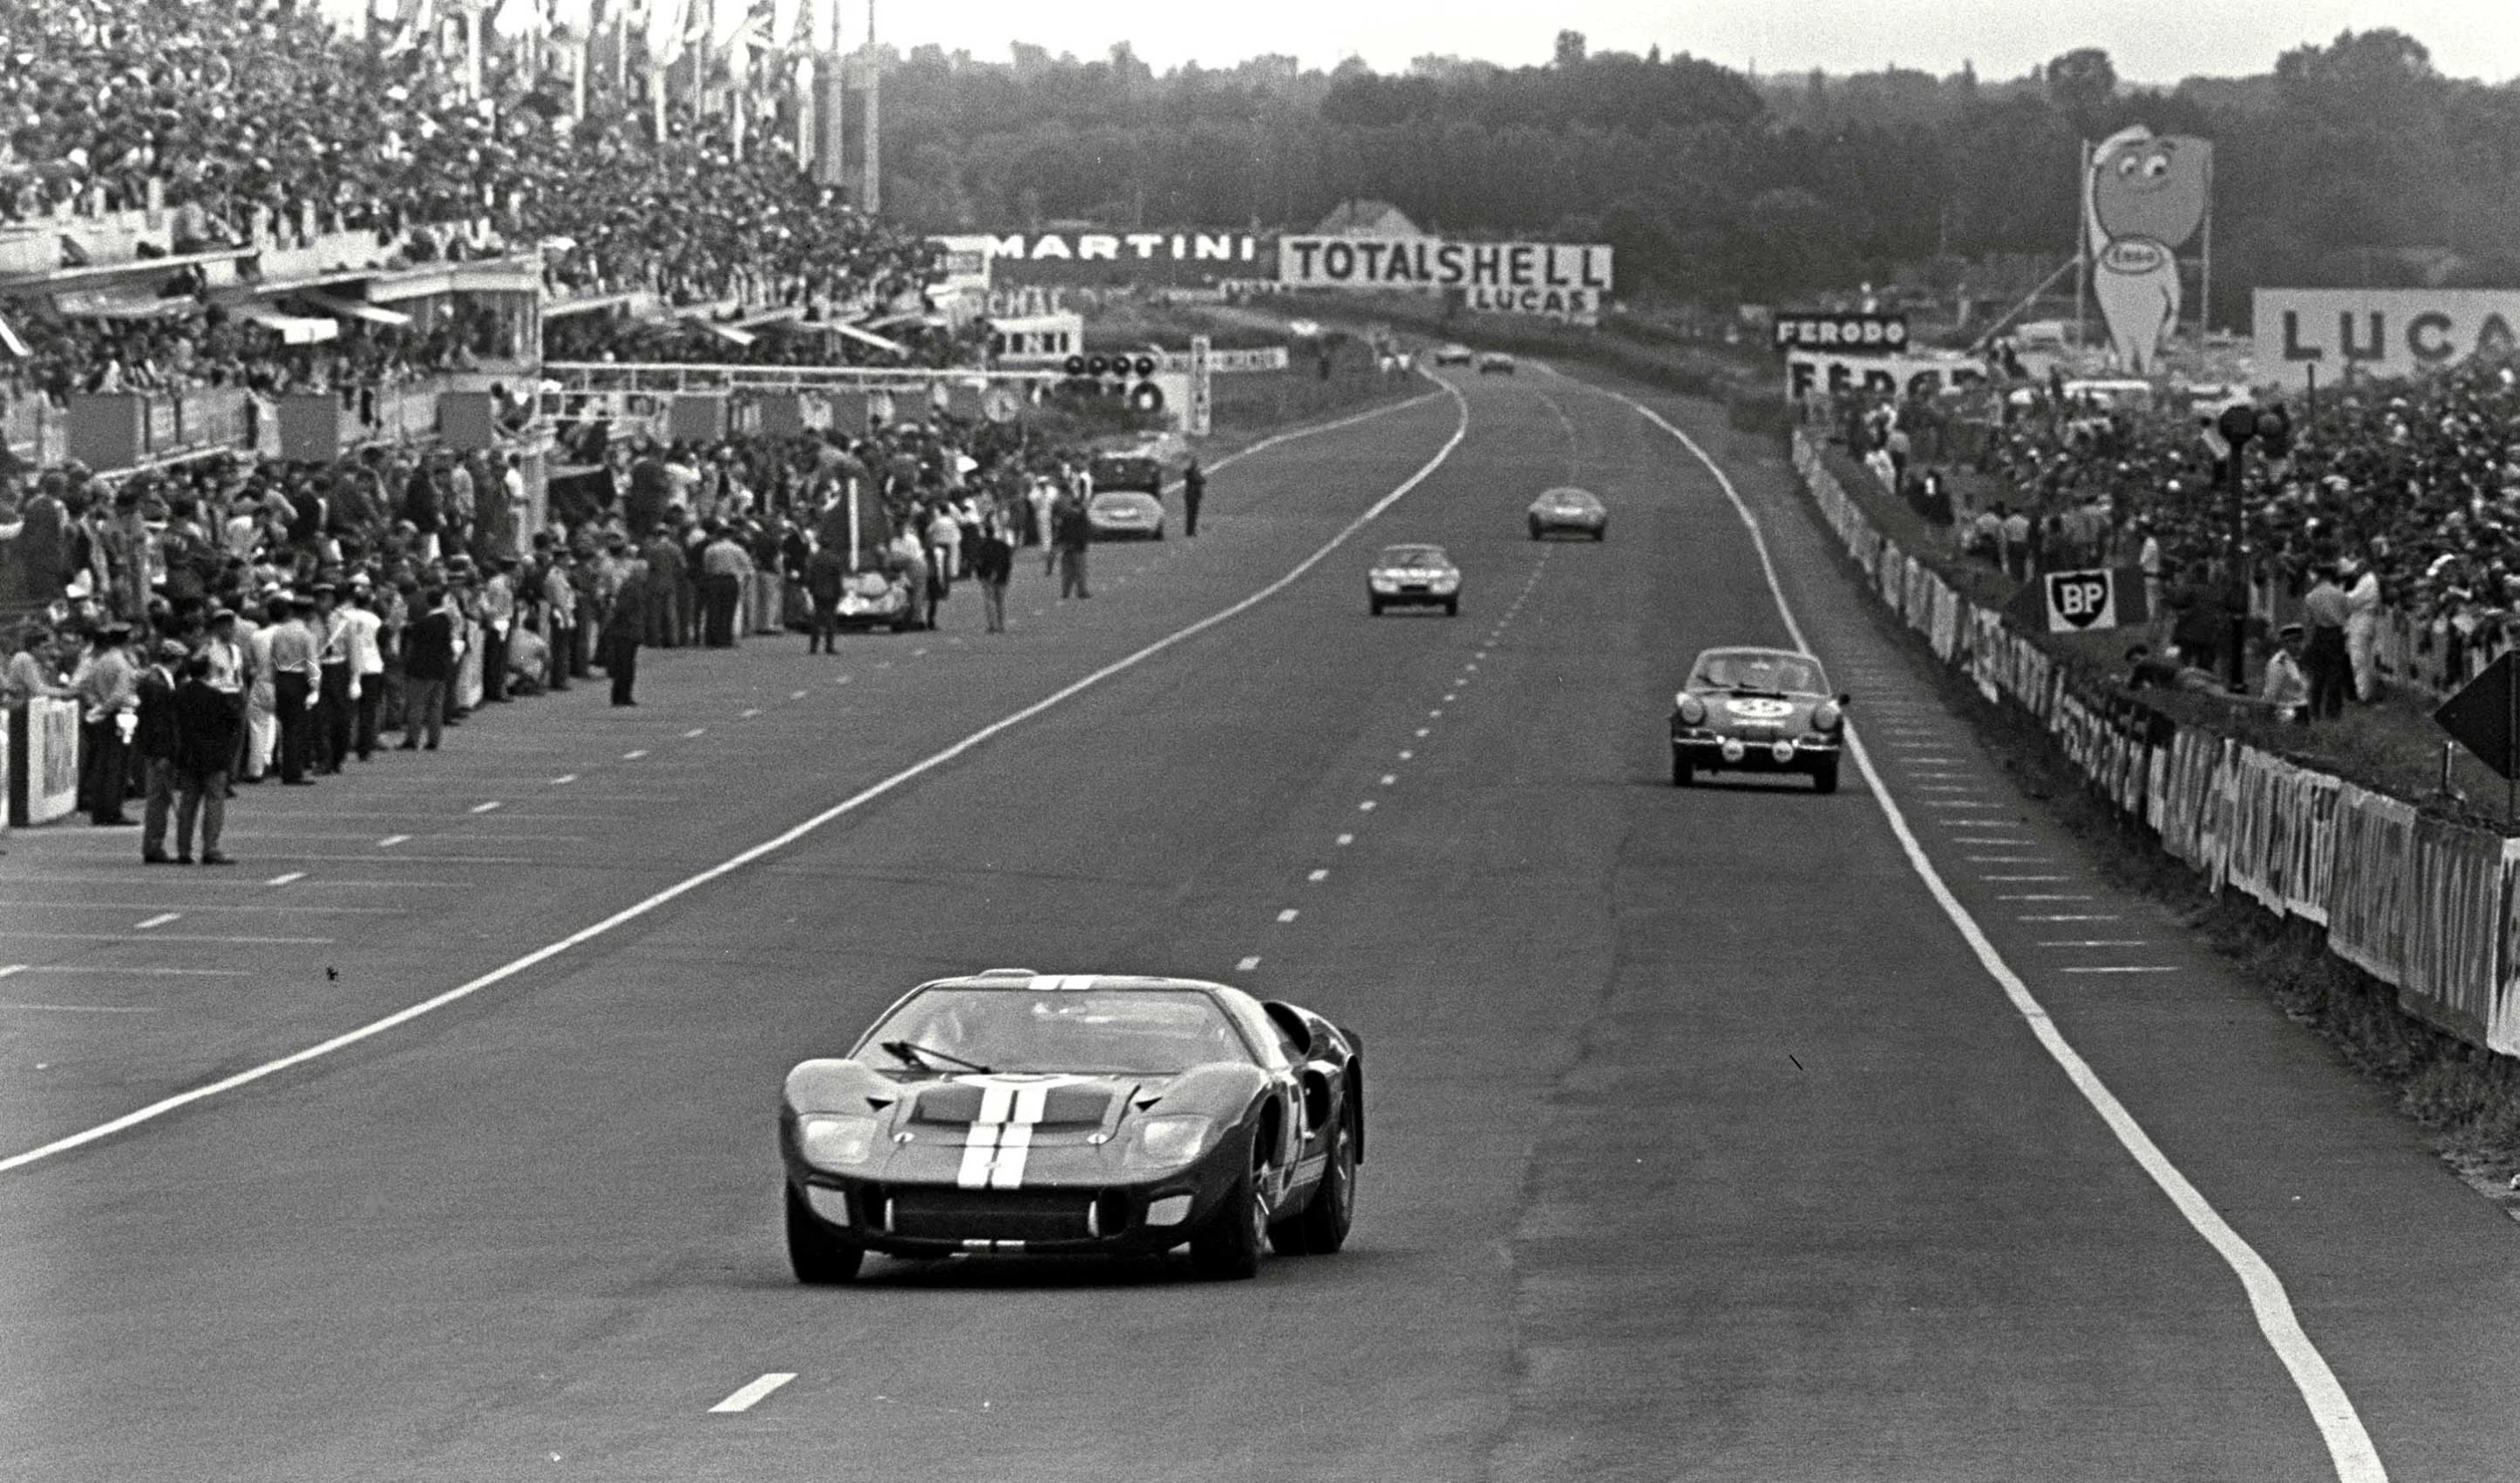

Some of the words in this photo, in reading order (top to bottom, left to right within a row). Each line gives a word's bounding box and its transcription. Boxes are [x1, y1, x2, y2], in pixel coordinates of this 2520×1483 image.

[986, 234, 1255, 261] MARTINI
[1290, 241, 1432, 281] TOTAL
[1437, 245, 1605, 288] SHELL
[1475, 290, 1588, 311] LUCAS
[1776, 321, 1905, 343] FERODO
[2060, 582, 2104, 615] BP
